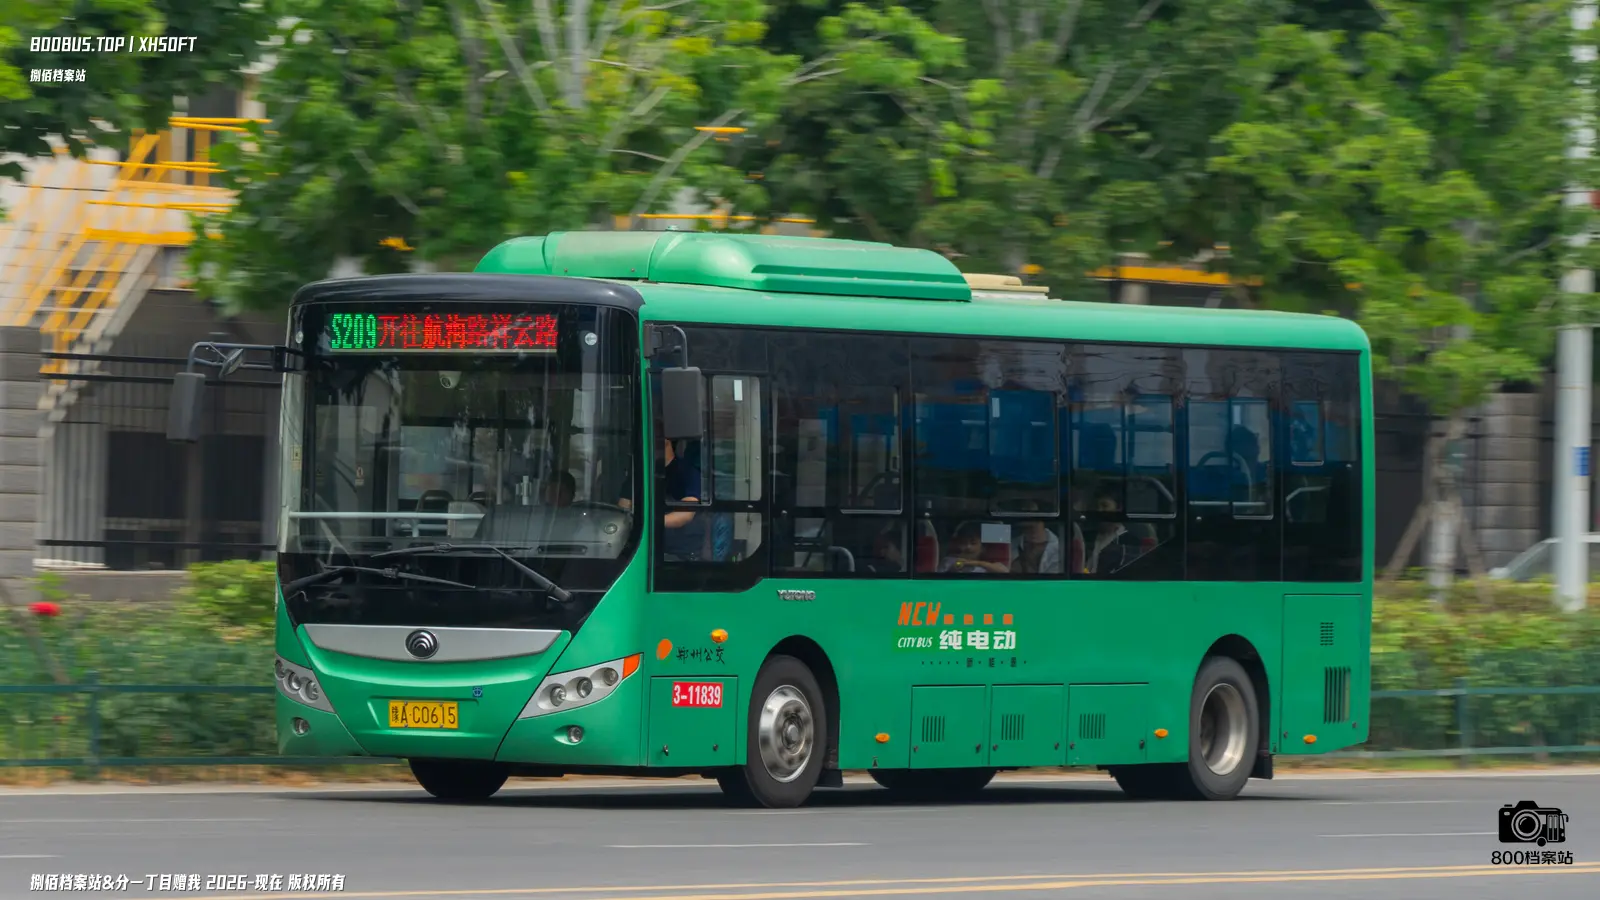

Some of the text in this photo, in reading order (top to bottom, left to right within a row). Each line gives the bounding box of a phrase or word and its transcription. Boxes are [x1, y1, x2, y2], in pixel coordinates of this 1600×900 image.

[897, 636, 933, 649] CITY BUS
[939, 630, 1017, 650] 纯电动
[676, 645, 726, 665] 郑州公交
[673, 684, 721, 706] 3-11839
